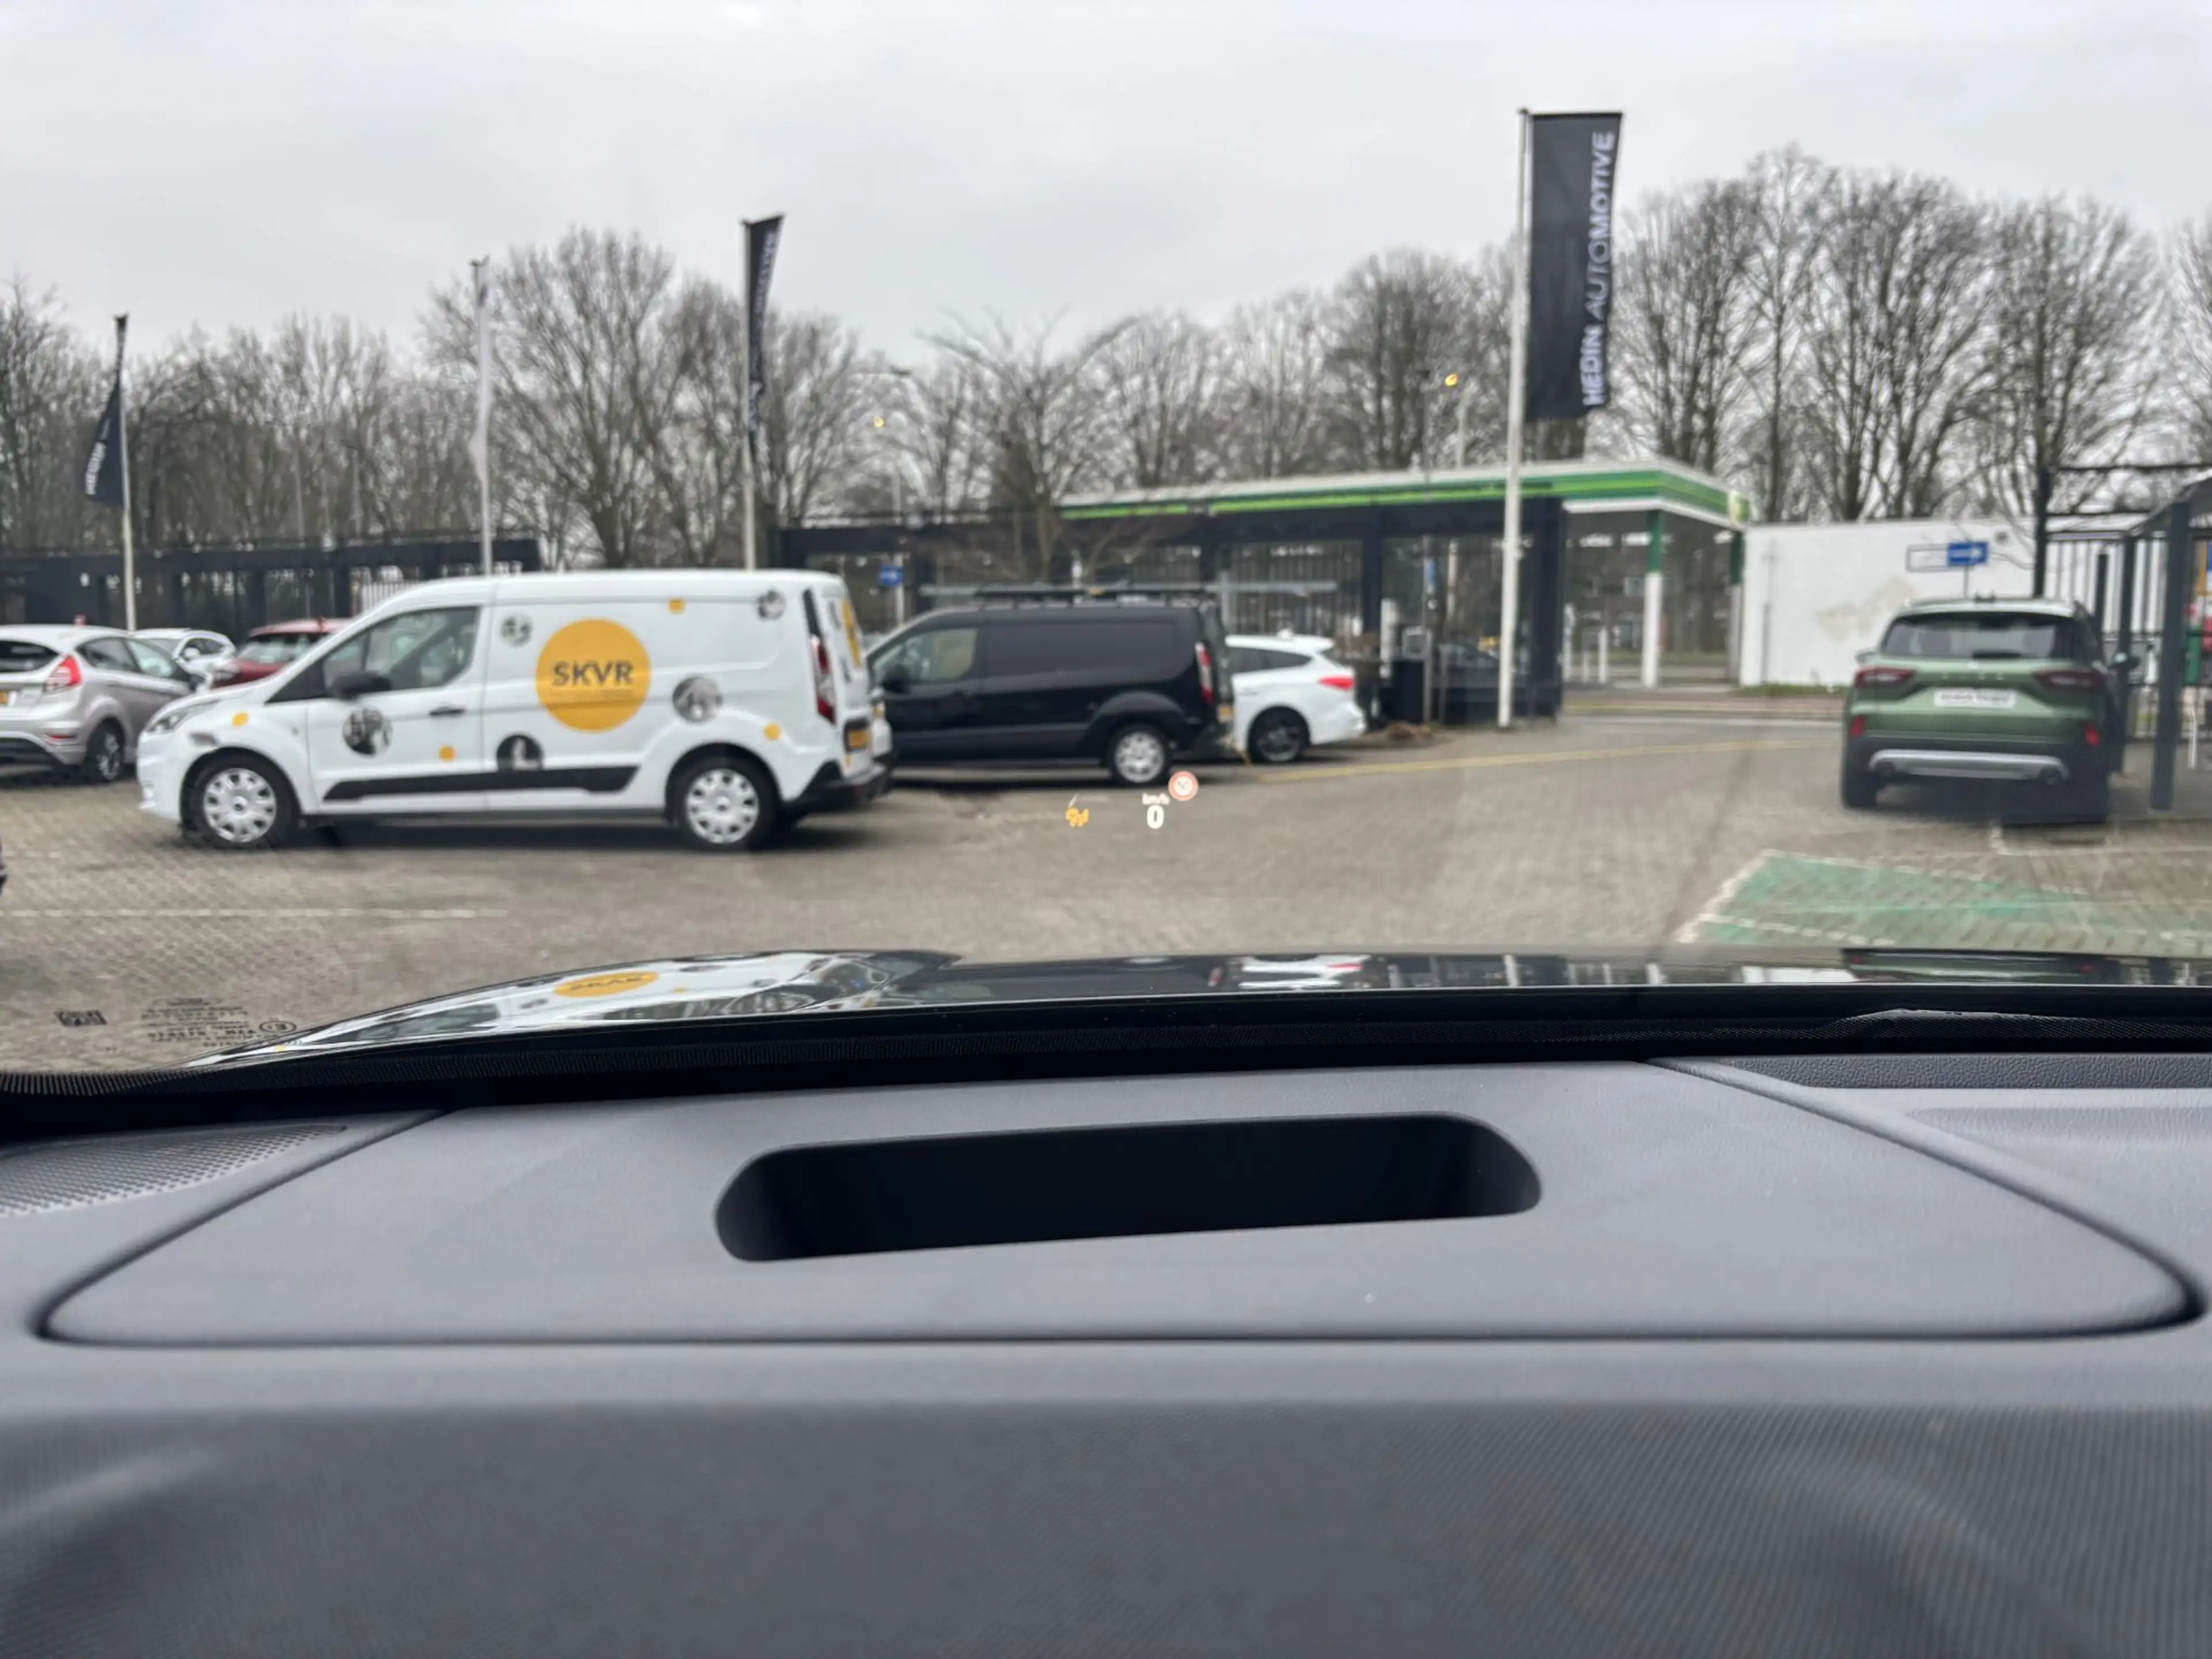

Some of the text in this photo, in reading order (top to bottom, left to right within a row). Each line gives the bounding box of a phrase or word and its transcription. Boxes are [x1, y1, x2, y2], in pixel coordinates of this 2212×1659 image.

[1580, 131, 1615, 406] HEDIN AUTOMOTIVE
[551, 660, 634, 686] SKVR
[1147, 805, 1164, 829] 0
